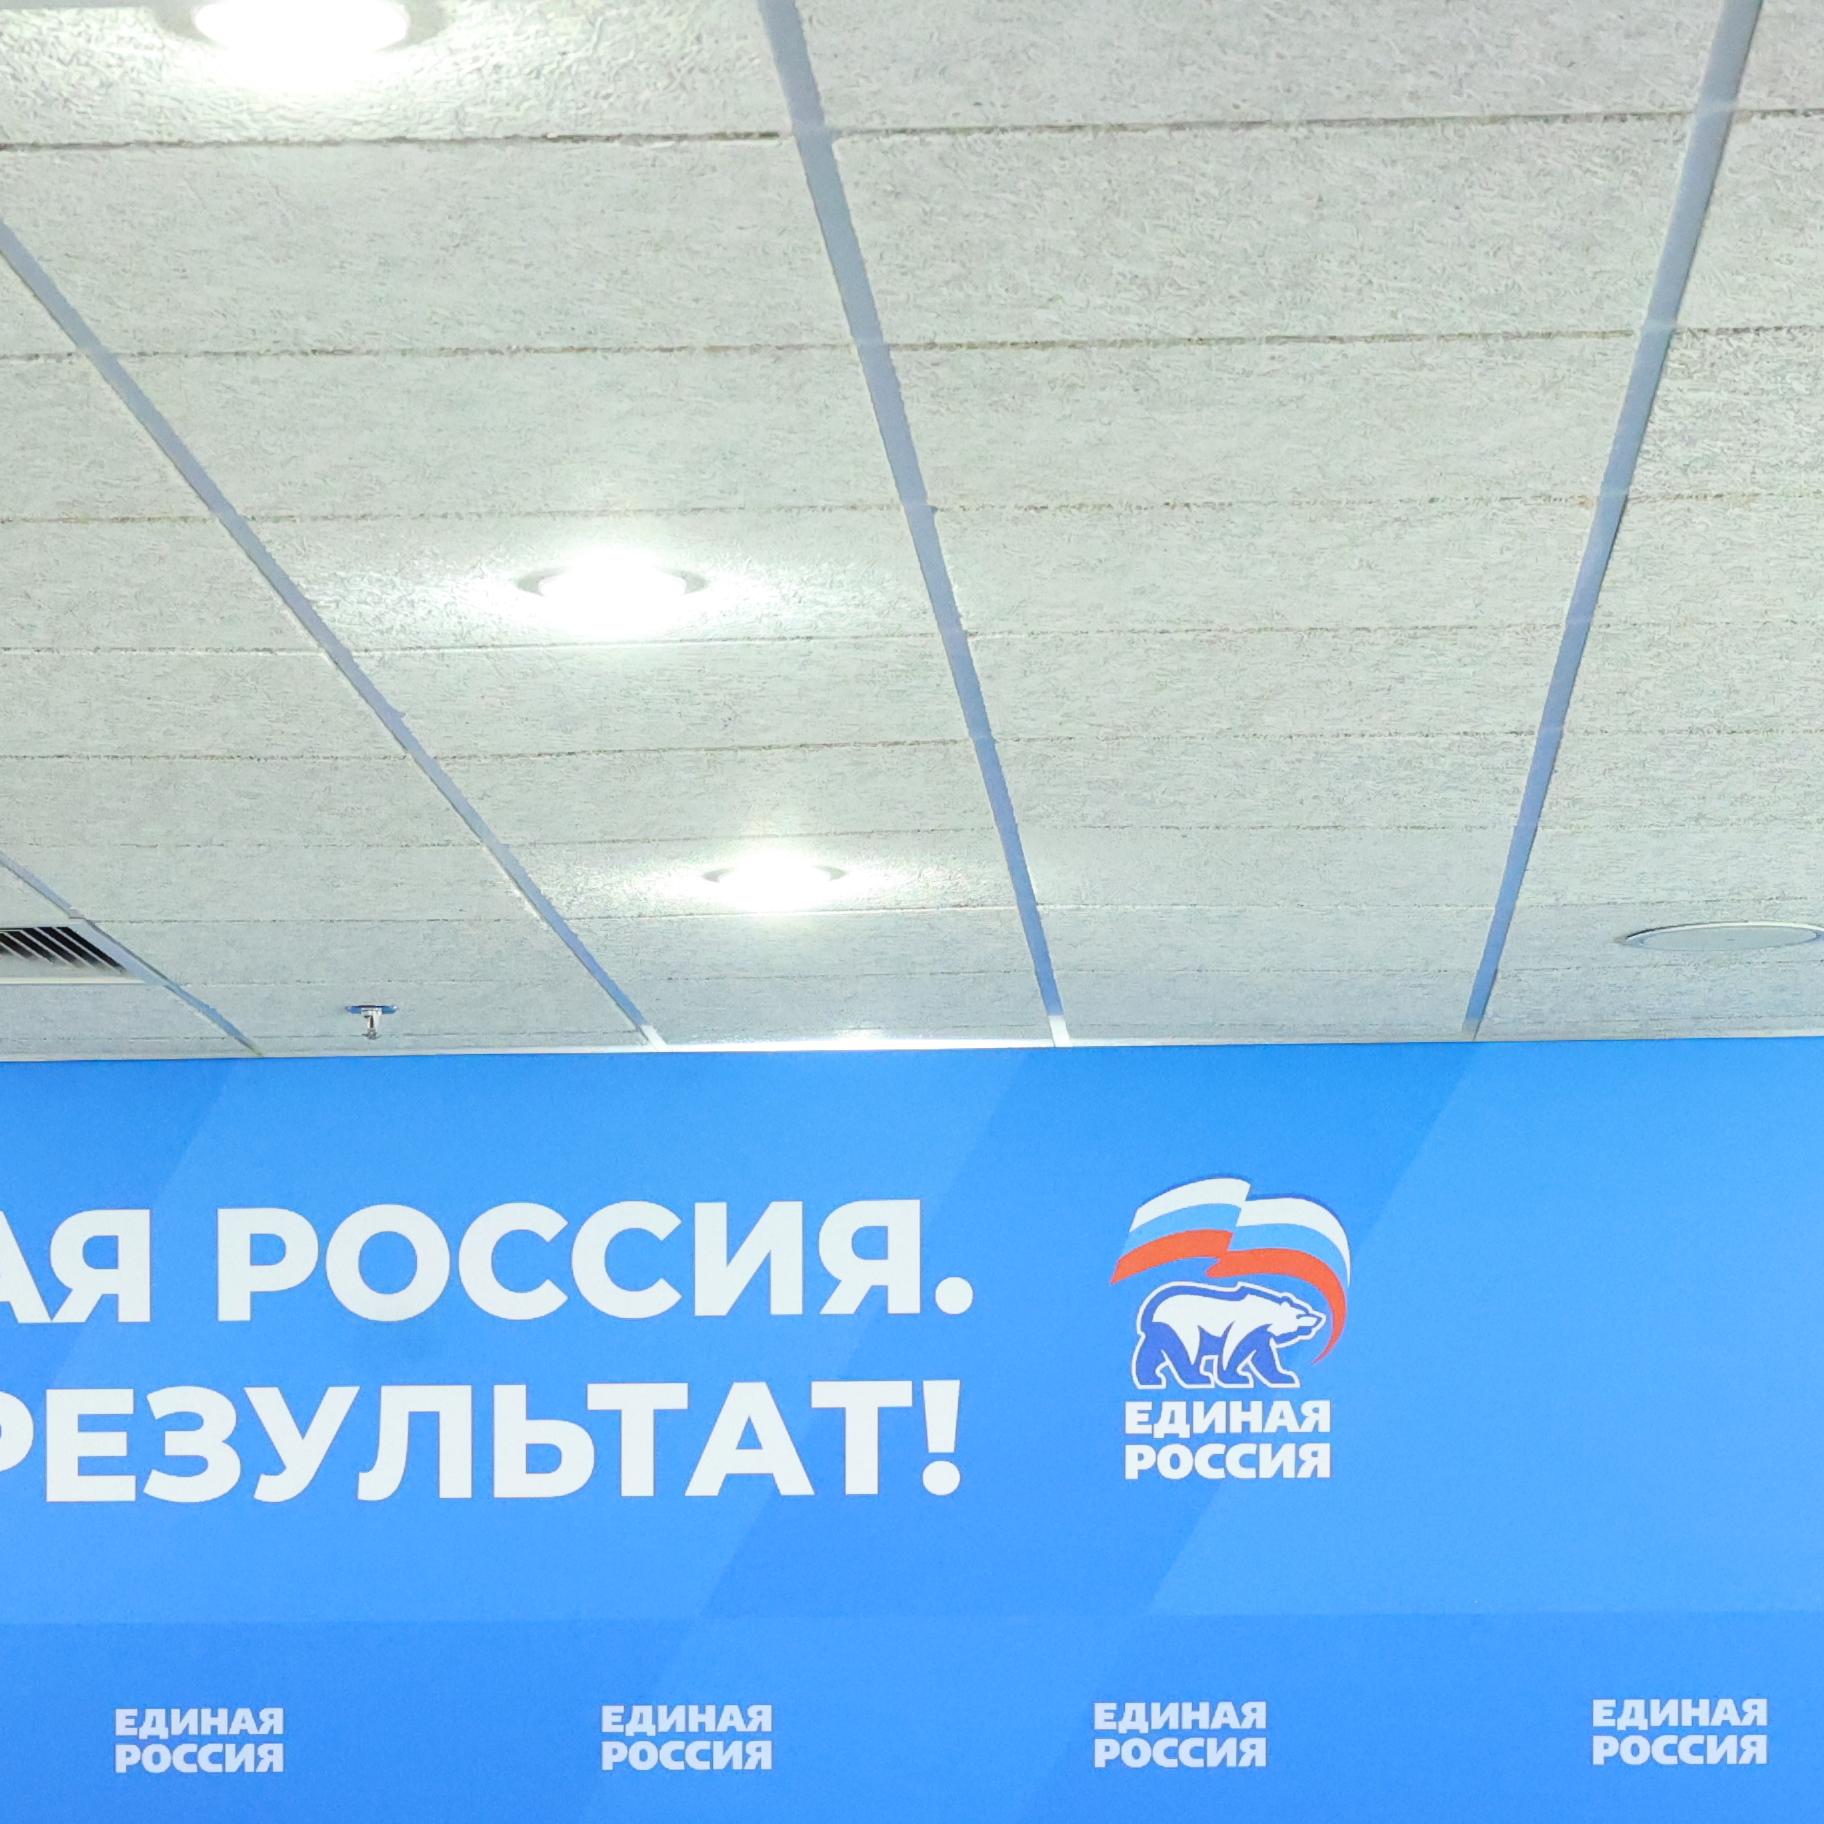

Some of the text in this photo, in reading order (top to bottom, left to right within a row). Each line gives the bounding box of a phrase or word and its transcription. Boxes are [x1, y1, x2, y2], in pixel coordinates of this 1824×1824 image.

[218, 1199, 973, 1325] РОССИЯ.
[1125, 1400, 1331, 1438] ЕДИНАЯ
[1125, 1443, 1331, 1479] РОССИЯ
[116, 1708, 283, 1739] ЕДИНАЯ
[602, 1705, 772, 1736] ЕДИНАЯ
[1095, 1702, 1266, 1733] ЕДИНАЯ
[1593, 1699, 1767, 1730] ЕДИНАЯ
[116, 1743, 283, 1773] РОССИЯ
[602, 1741, 772, 1770] РОССИЯ
[1095, 1738, 1266, 1768] РОССИЯ
[1593, 1735, 1767, 1765] РОССИЯ
